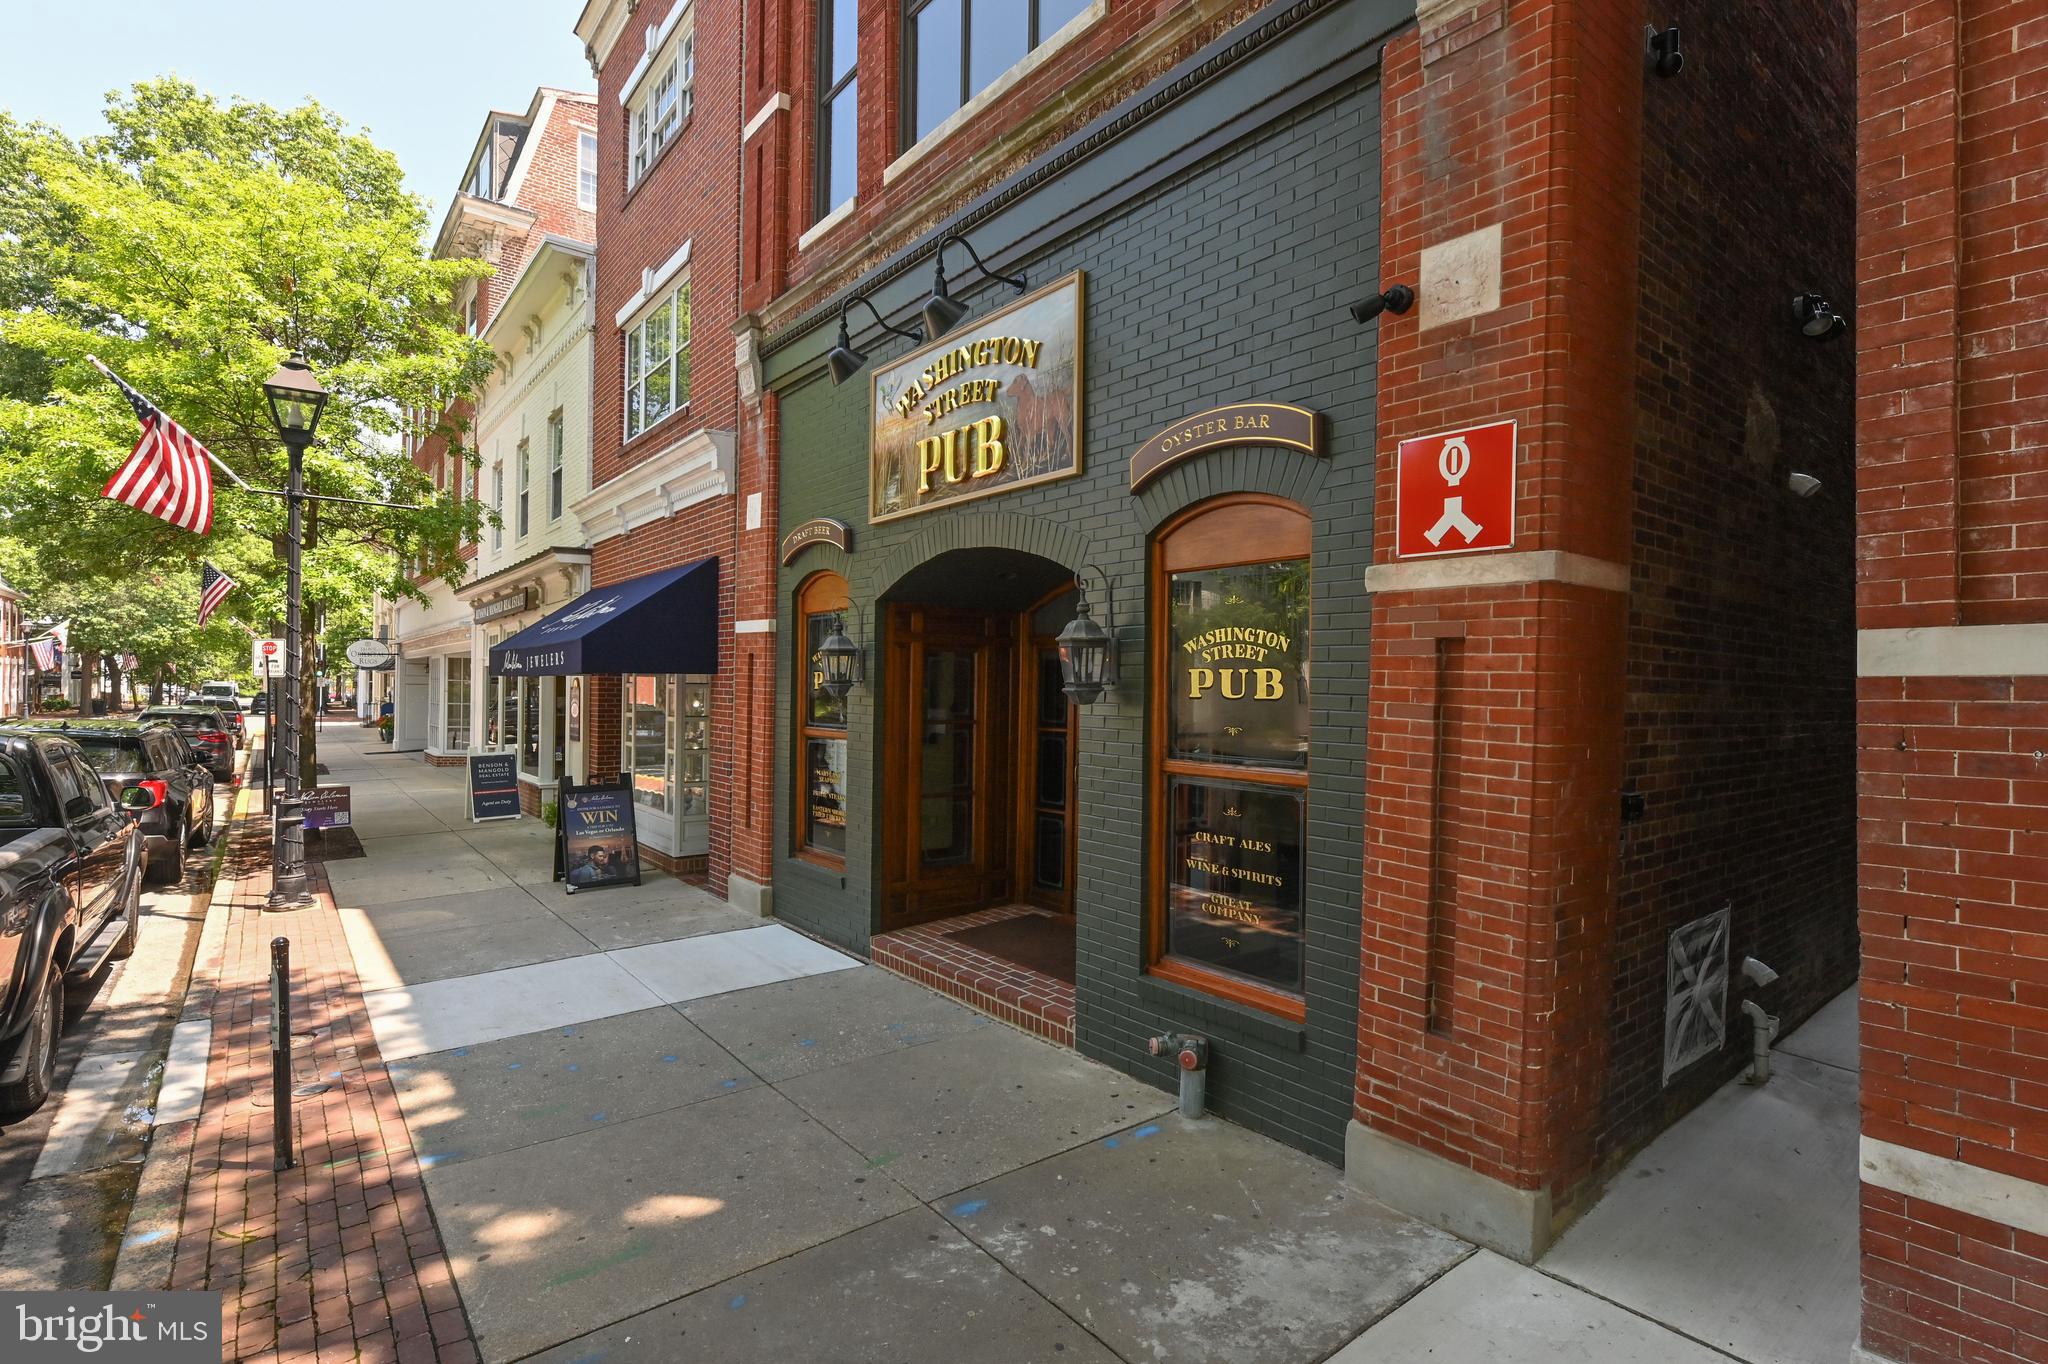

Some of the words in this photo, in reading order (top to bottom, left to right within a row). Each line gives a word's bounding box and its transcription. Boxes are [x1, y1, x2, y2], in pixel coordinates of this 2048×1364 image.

[895, 336, 1041, 418] WASHINGTON
[923, 379, 998, 425] STREET
[1161, 419, 1228, 452] OYSTER
[1234, 414, 1270, 430] BAR
[916, 415, 1004, 494] PUB
[792, 527, 813, 544] DRAFT
[814, 525, 830, 535] BEER
[1183, 627, 1291, 654] WASHINGTON
[526, 651, 565, 671] JEWELERS
[1202, 644, 1268, 663] STREET
[1188, 668, 1284, 700] PUB
[580, 810, 618, 824] WIN
[1195, 831, 1236, 846] CRAFT
[1240, 839, 1272, 853] ALES
[1186, 858, 1219, 874] WINE
[1221, 866, 1229, 876] &
[1231, 868, 1282, 887] SPIRITS
[1201, 902, 1261, 925] COMPANY
[1211, 894, 1253, 911] GREAT
